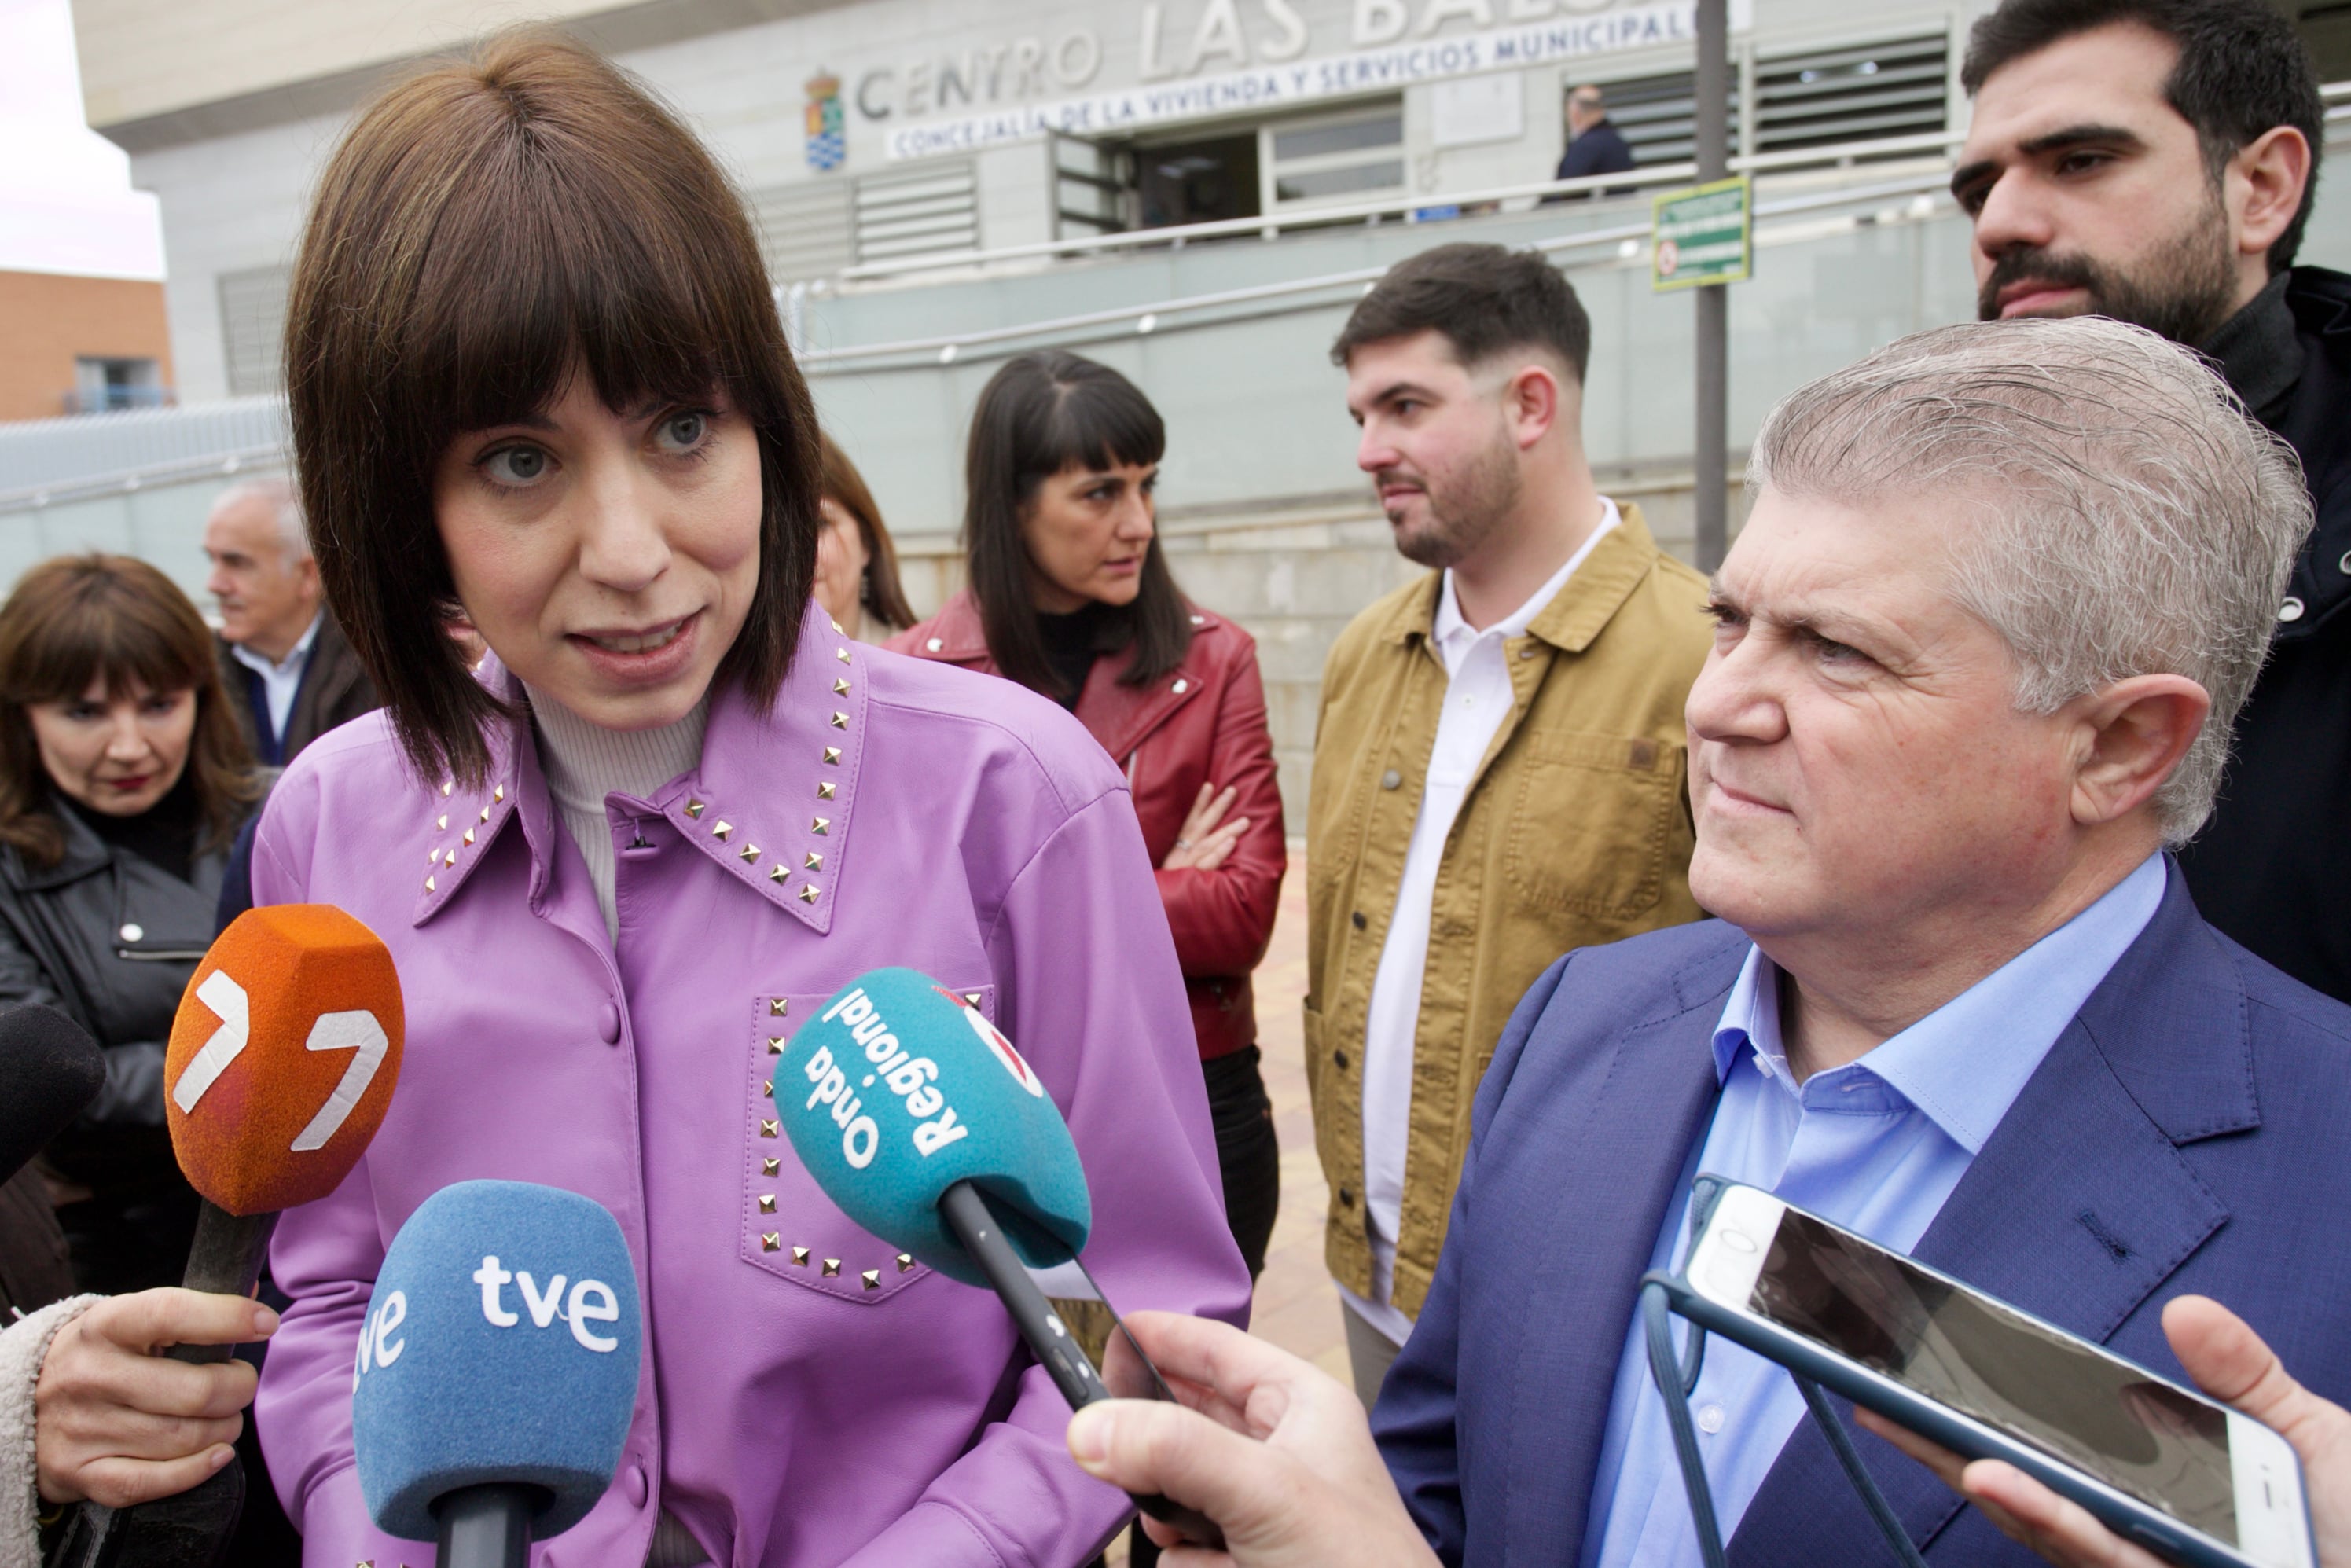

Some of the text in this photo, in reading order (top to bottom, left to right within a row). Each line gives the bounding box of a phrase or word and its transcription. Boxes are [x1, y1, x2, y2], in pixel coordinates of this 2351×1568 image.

[855, 30, 1100, 121] CENTRO
[1138, 0, 1307, 81] LAS
[1060, 101, 1091, 130] DE
[1103, 97, 1134, 122] LA
[1145, 75, 1279, 114] VIVIENDA
[1291, 66, 1309, 91] Y
[1319, 42, 1478, 89] SERVICIOS
[1493, 8, 1697, 61] MUNICIPAL
[172, 969, 250, 1114] 7
[290, 1009, 389, 1151] 7
[821, 987, 968, 1157] Regional
[804, 1046, 880, 1170] Onda
[473, 1254, 619, 1353] tve
